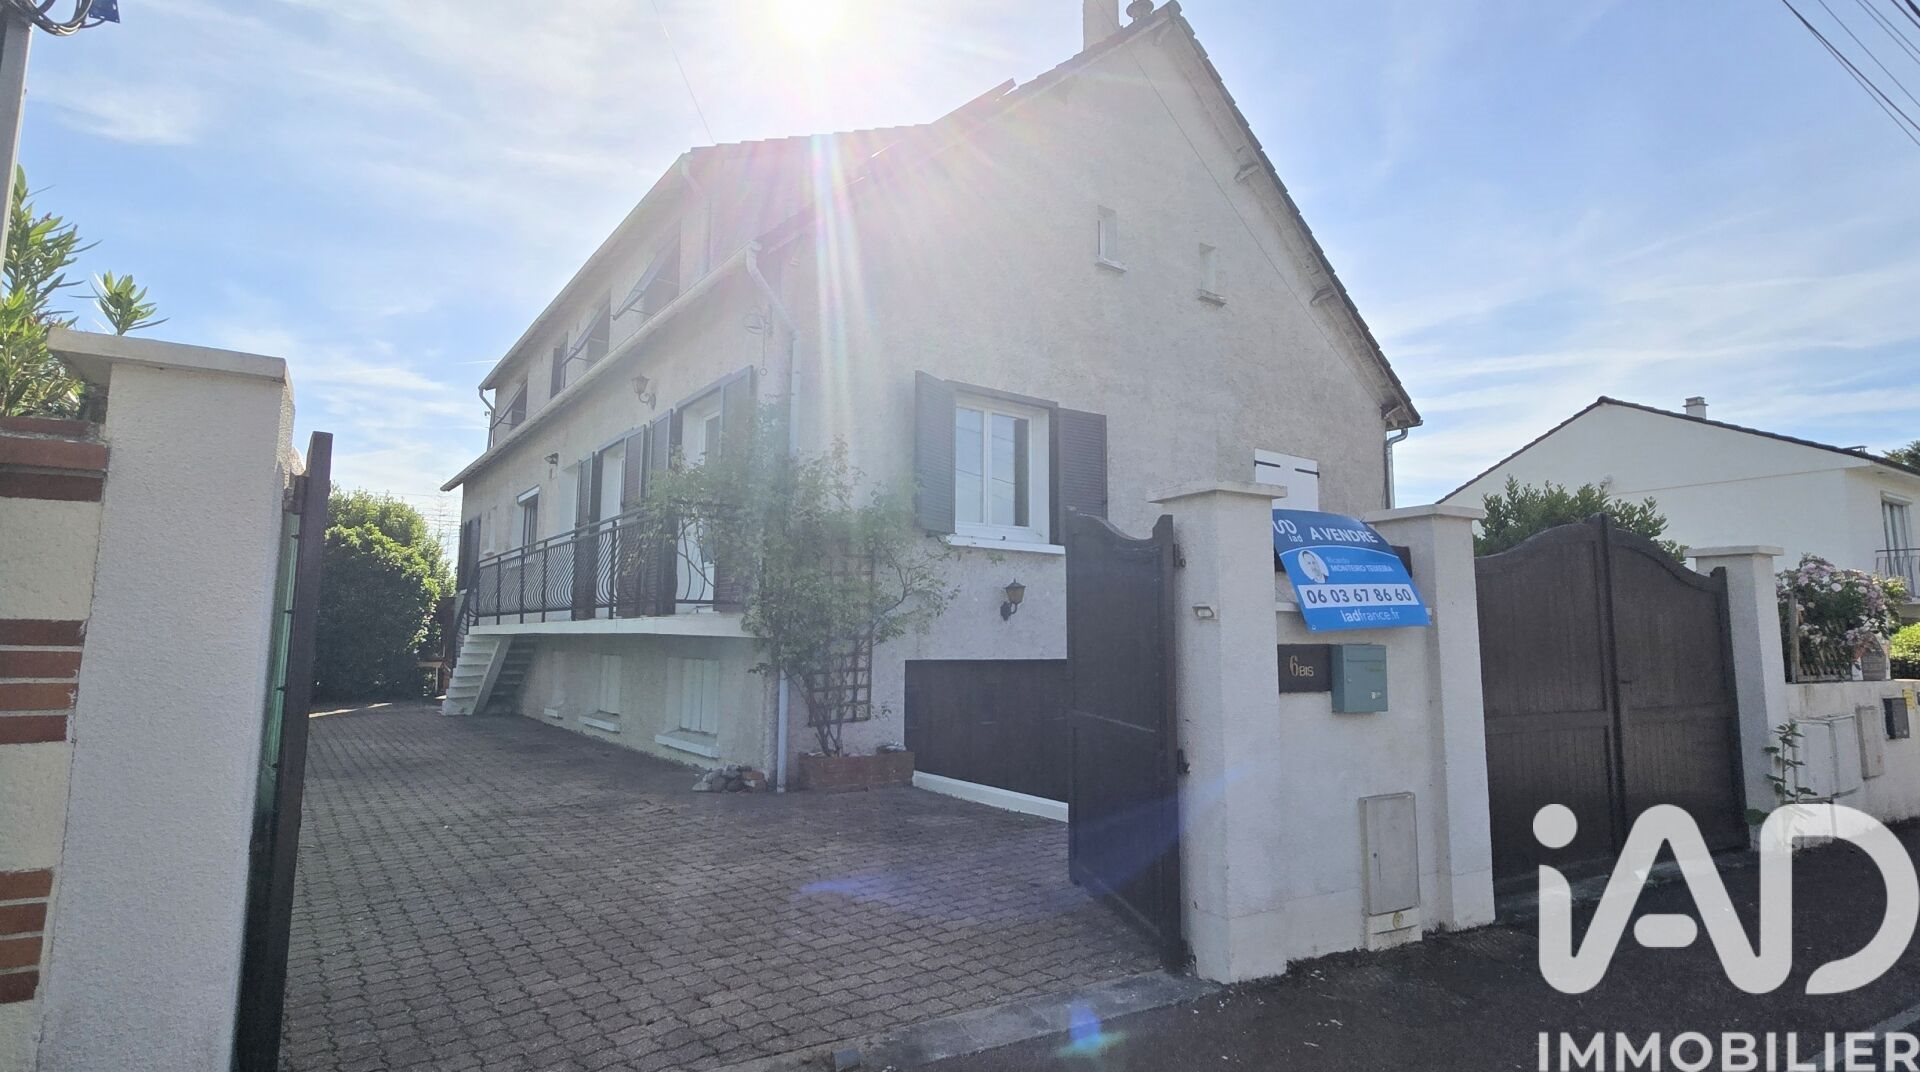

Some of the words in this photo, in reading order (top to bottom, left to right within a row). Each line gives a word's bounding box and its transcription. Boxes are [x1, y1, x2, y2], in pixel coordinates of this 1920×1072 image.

[1309, 526, 1323, 541] A
[1320, 527, 1379, 543] VENDRE
[1306, 589, 1328, 604] 06
[1330, 588, 1350, 603] 03
[1353, 588, 1369, 602] 67
[1373, 588, 1393, 602] 86
[1395, 588, 1412, 601] 60
